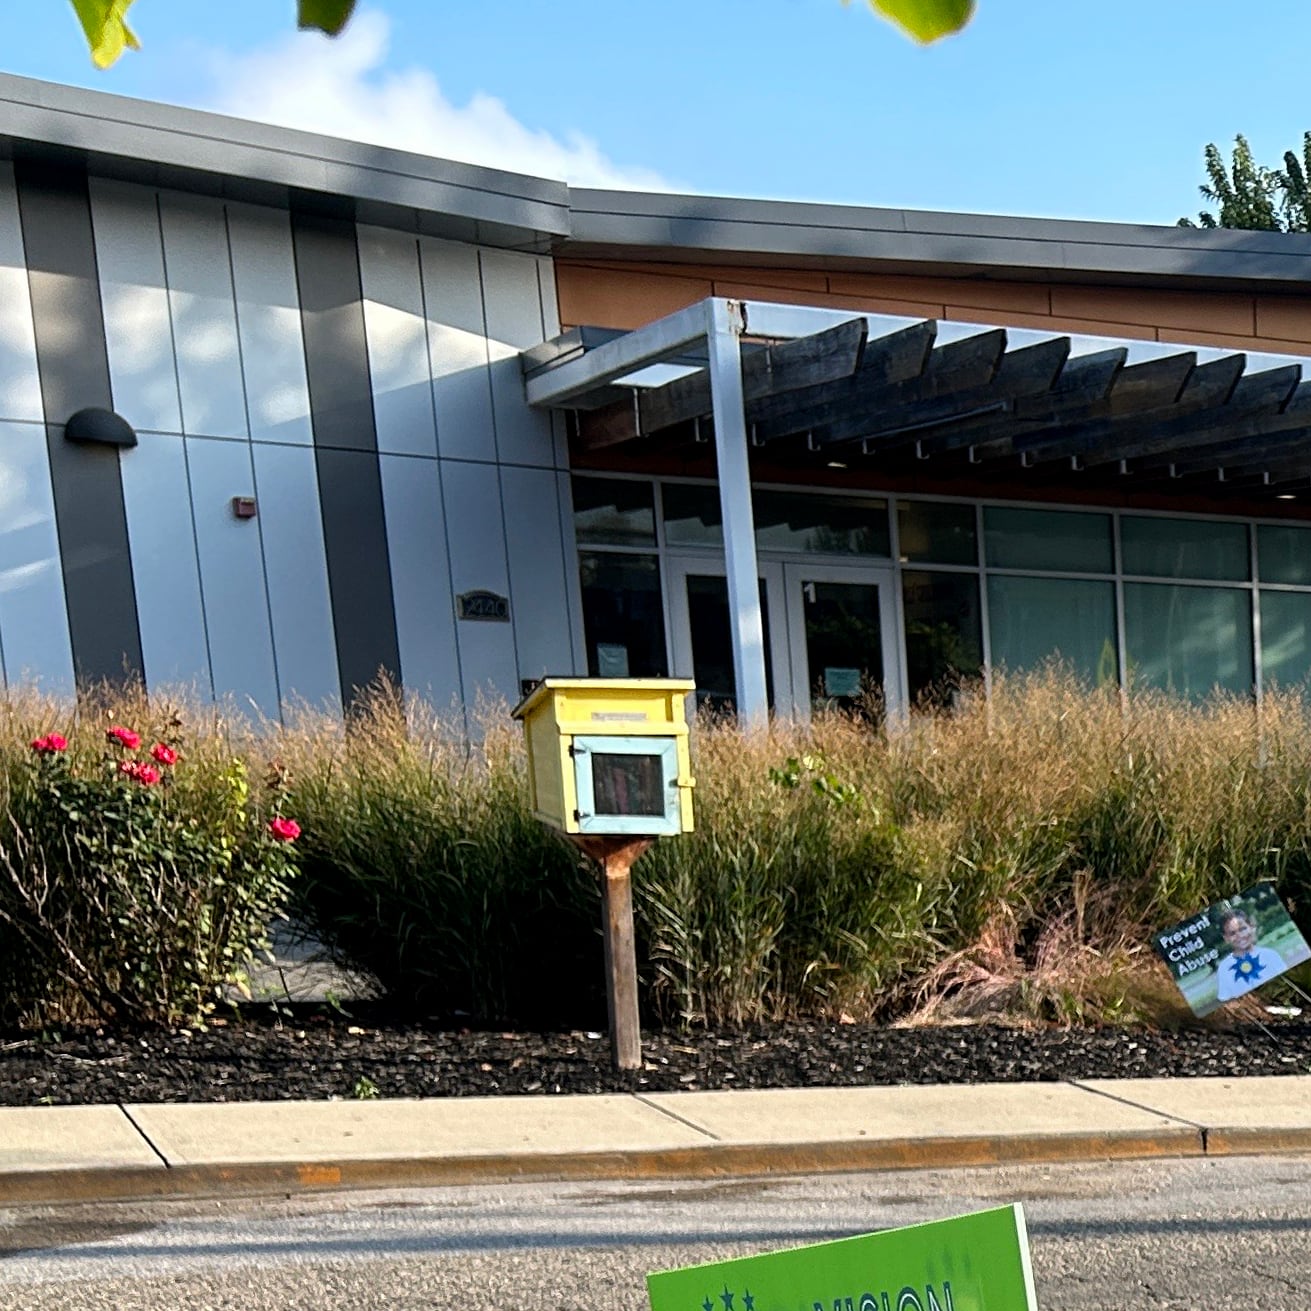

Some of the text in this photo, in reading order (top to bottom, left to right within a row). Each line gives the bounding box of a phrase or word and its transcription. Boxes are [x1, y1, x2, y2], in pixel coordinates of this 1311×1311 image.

[1159, 916, 1211, 949] Prevent
[1168, 936, 1205, 962] Child
[1178, 948, 1219, 977] Abuse
